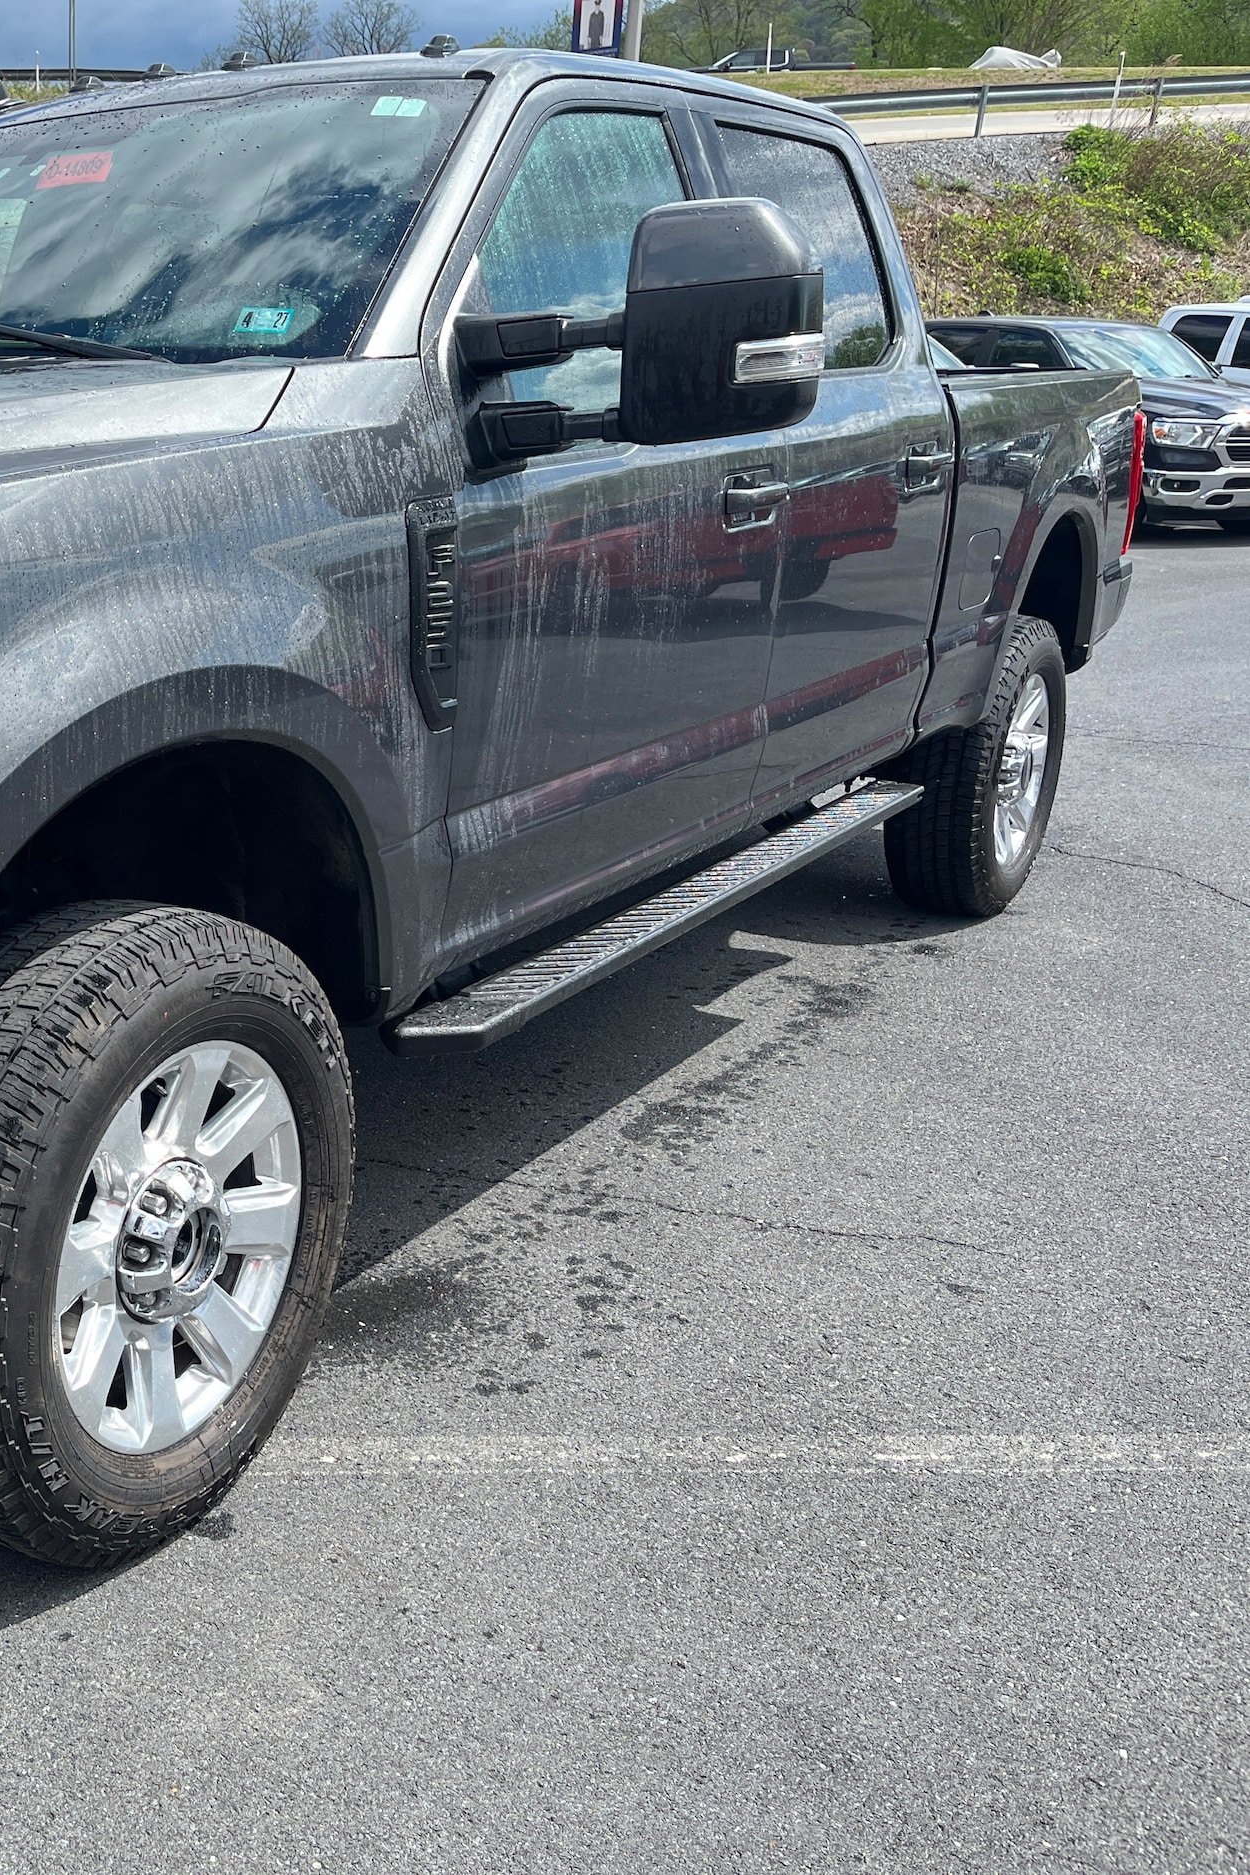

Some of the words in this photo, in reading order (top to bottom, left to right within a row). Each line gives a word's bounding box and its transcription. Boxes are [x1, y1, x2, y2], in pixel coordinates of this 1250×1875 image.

[242, 311, 254, 328] 4
[272, 311, 289, 328] 27
[205, 971, 338, 1071] FALKEN
